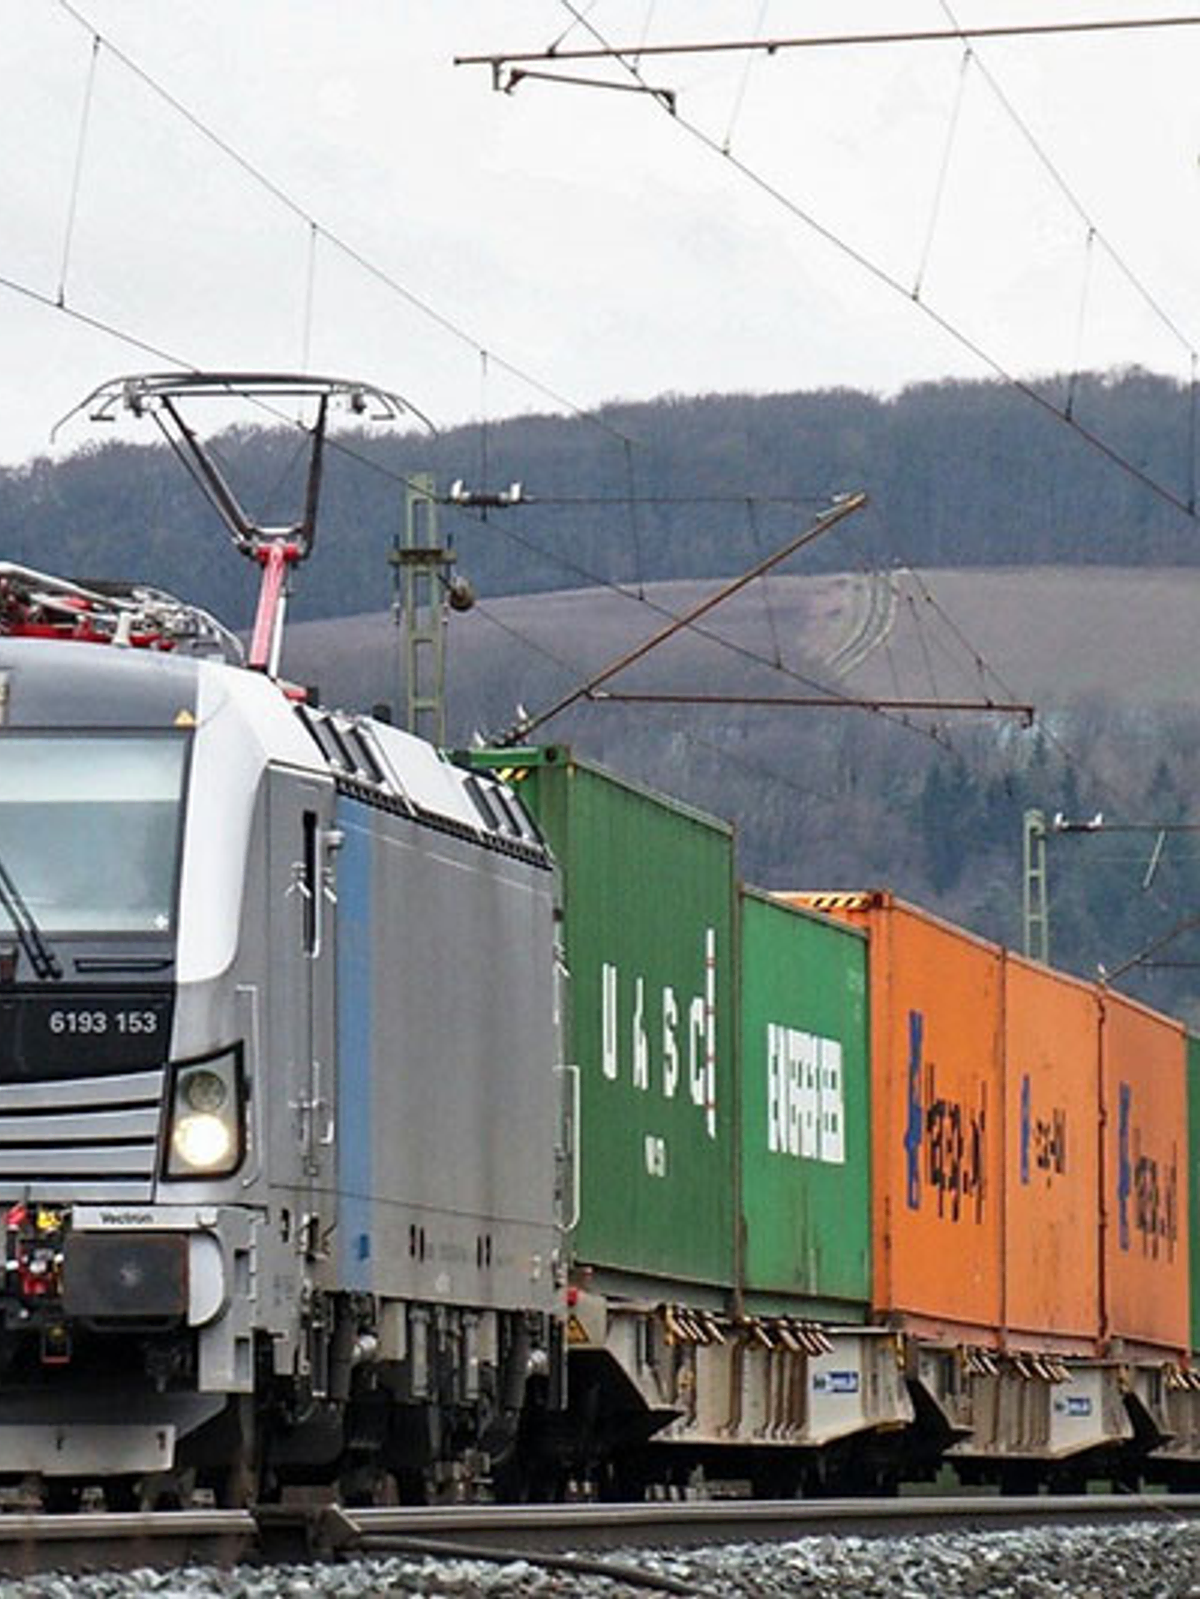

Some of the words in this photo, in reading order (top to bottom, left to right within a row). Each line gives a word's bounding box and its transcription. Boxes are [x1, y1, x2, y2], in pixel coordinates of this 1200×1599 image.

[50, 1010, 108, 1034] 6193
[114, 1010, 158, 1034] 153
[99, 1211, 155, 1225] Vectron
